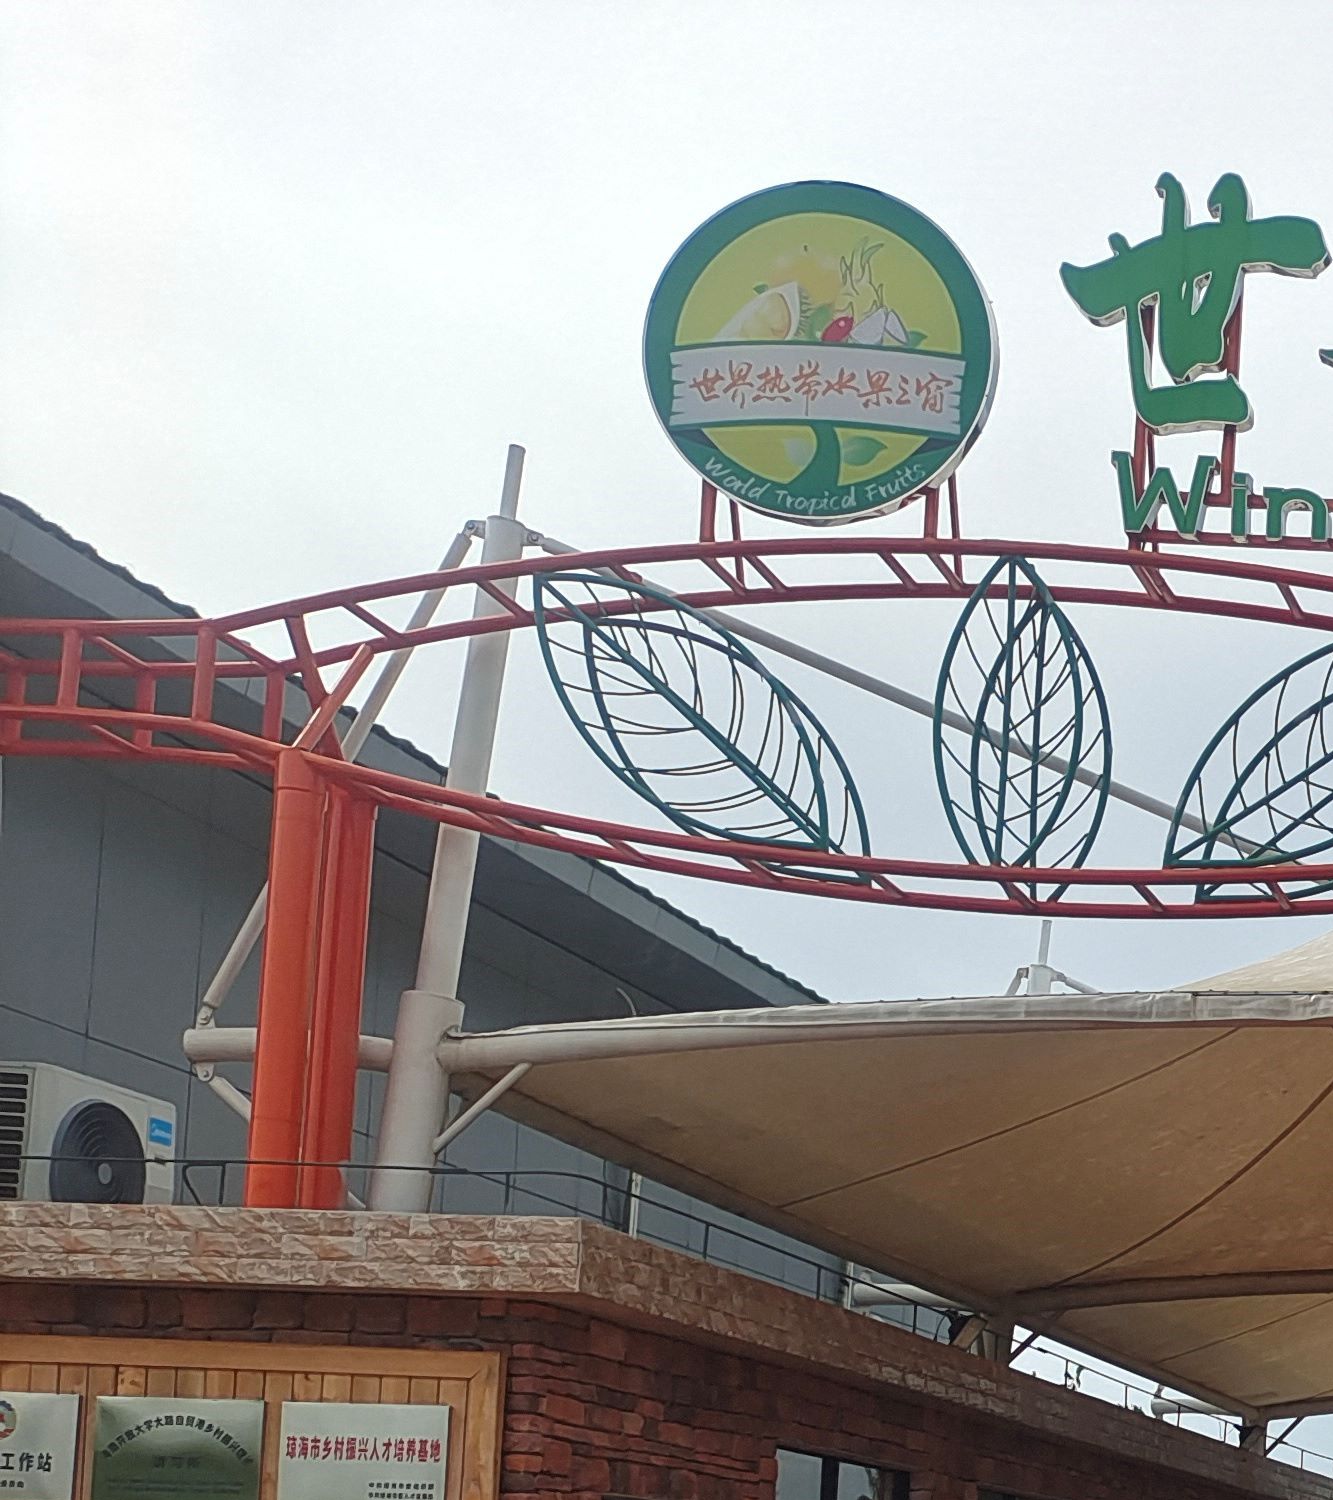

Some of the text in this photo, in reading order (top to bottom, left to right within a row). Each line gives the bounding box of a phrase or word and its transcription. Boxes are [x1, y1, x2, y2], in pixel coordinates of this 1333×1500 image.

[689, 360, 954, 416] 世界热带水果之窗
[705, 456, 925, 514] World Tropical Fruits
[286, 1435, 441, 1463] 琼海市乡村振兴人才培养基地
